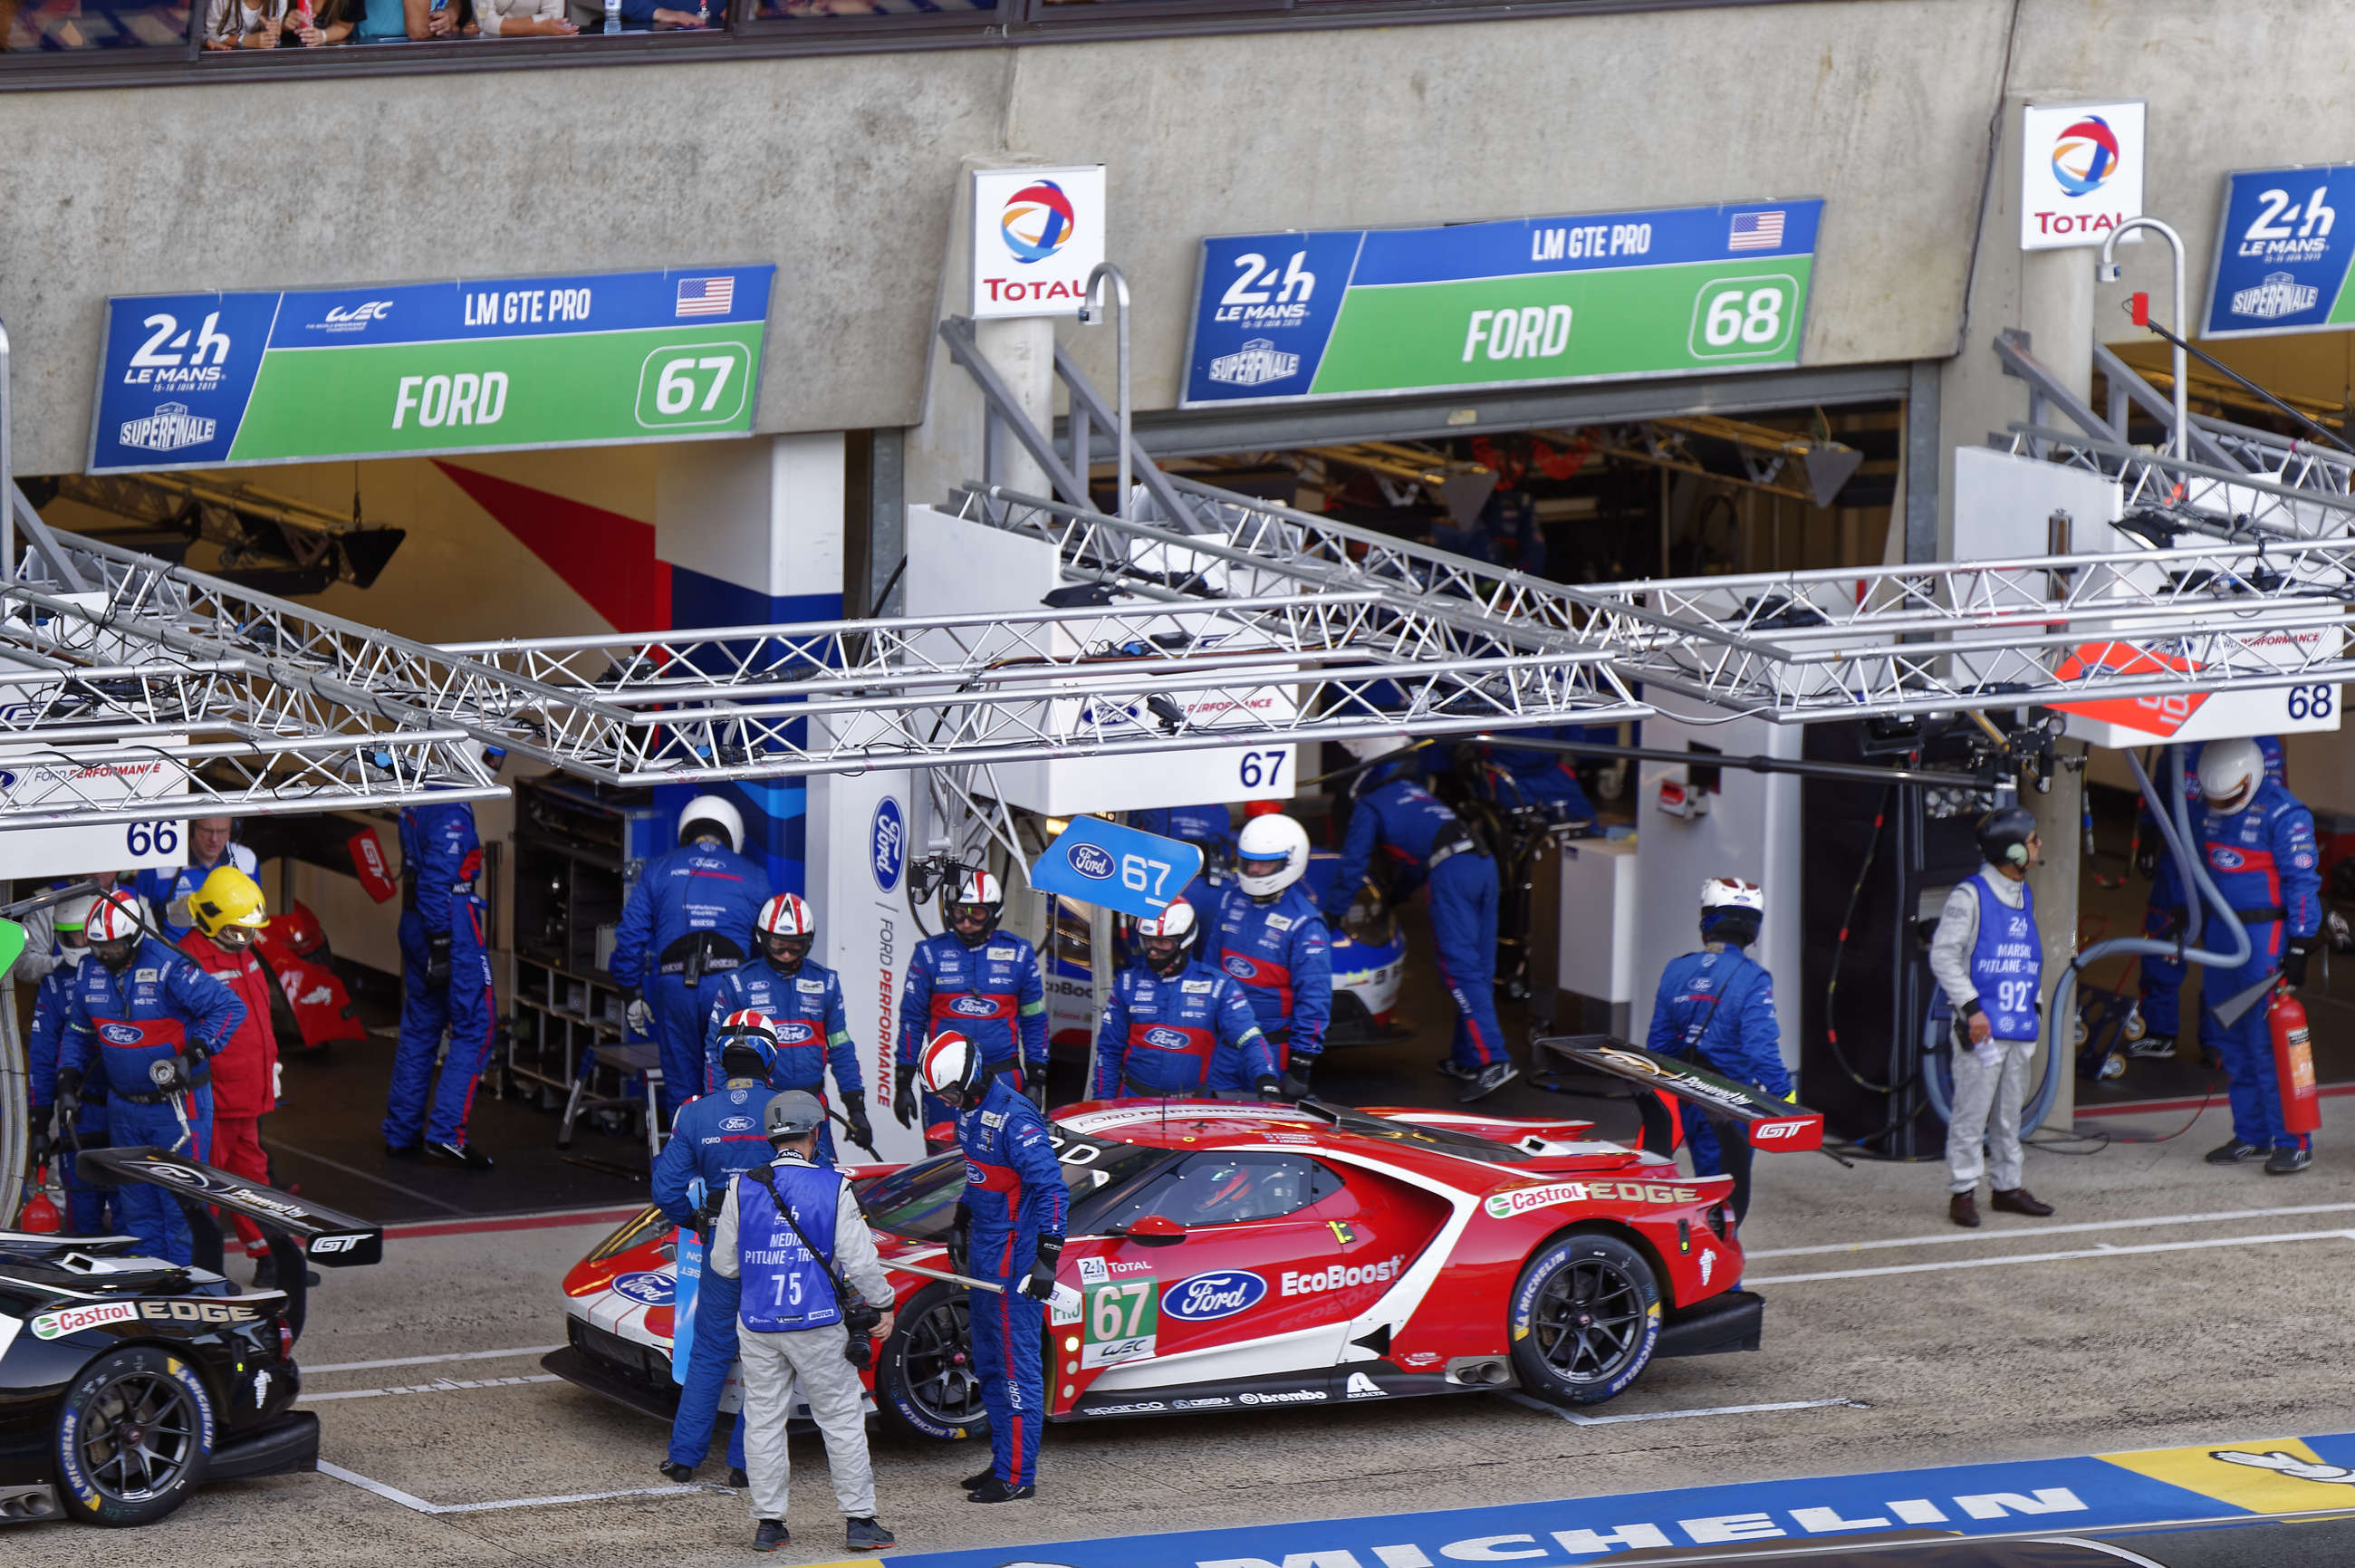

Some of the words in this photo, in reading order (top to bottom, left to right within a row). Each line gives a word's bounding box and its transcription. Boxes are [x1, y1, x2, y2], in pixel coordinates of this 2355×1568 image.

[2244, 186, 2335, 240] 24h
[1532, 228, 1566, 261] LM
[1568, 226, 1609, 258] GTE
[1610, 223, 1651, 255] PRO
[2238, 241, 2265, 256] LE
[2266, 237, 2326, 255] MANS
[1220, 250, 1316, 304] 24h
[464, 292, 499, 326] LM
[503, 290, 543, 323] GTE
[547, 288, 591, 322] PRO
[1215, 306, 1243, 321] LE
[1244, 303, 1306, 319] MANS
[1705, 287, 1783, 346] 68
[2234, 284, 2316, 316] SUPERFINALE
[130, 311, 230, 367] 24h
[1462, 304, 1573, 361] FORD
[124, 369, 154, 384] LE
[155, 366, 222, 383] MANS
[1211, 351, 1297, 381] SUPERFINALE
[391, 370, 509, 429] FORD
[655, 355, 735, 416] 67
[121, 414, 215, 449] SUPERFINALE
[2288, 684, 2333, 720] 68
[1240, 750, 1286, 788] 67
[127, 819, 178, 857] 66
[876, 814, 900, 879] Ford
[1075, 846, 1107, 875] Ford
[1121, 852, 1171, 896] 67
[879, 918, 894, 967] FORD
[1978, 959, 2022, 974] PITLANE
[1998, 981, 2028, 1013] 92
[875, 967, 893, 1107] PERFORMANCE
[1683, 1076, 1735, 1102] Powered
[1733, 1091, 1754, 1105] by
[1078, 1111, 1134, 1128] FORD
[1139, 1108, 1306, 1118] PERFORMANCE
[1755, 1120, 1818, 1139] GT
[701, 1136, 721, 1145] FORD
[232, 1188, 291, 1214] Powered
[285, 1203, 310, 1218] by
[1511, 1186, 1581, 1210] Castrol
[1587, 1182, 1704, 1204] EDGE
[310, 1233, 375, 1253] GT
[745, 1250, 787, 1265] PITLANE
[1109, 1260, 1152, 1273] TOTAL
[1281, 1255, 1402, 1297] EcoBoost
[1519, 1251, 1566, 1313] MICHELIN
[620, 1274, 674, 1301] Ford
[771, 1272, 803, 1306] 75
[1181, 1277, 1247, 1315] Ford
[59, 1304, 132, 1331] Castrol
[139, 1301, 262, 1323] EDGE
[1092, 1282, 1150, 1342] 67
[1101, 1340, 1148, 1357] WEC
[1612, 1332, 1658, 1392] MICHELIN
[1007, 1380, 1023, 1410] FORD
[1082, 1401, 1166, 1416] sparco
[1258, 1390, 1328, 1403] brembo
[187, 1377, 214, 1448] MICHELIN
[900, 1403, 947, 1436] MICHELIN
[62, 1414, 85, 1489] MICHELIN
[1195, 1486, 2091, 1568] MICHELIN
